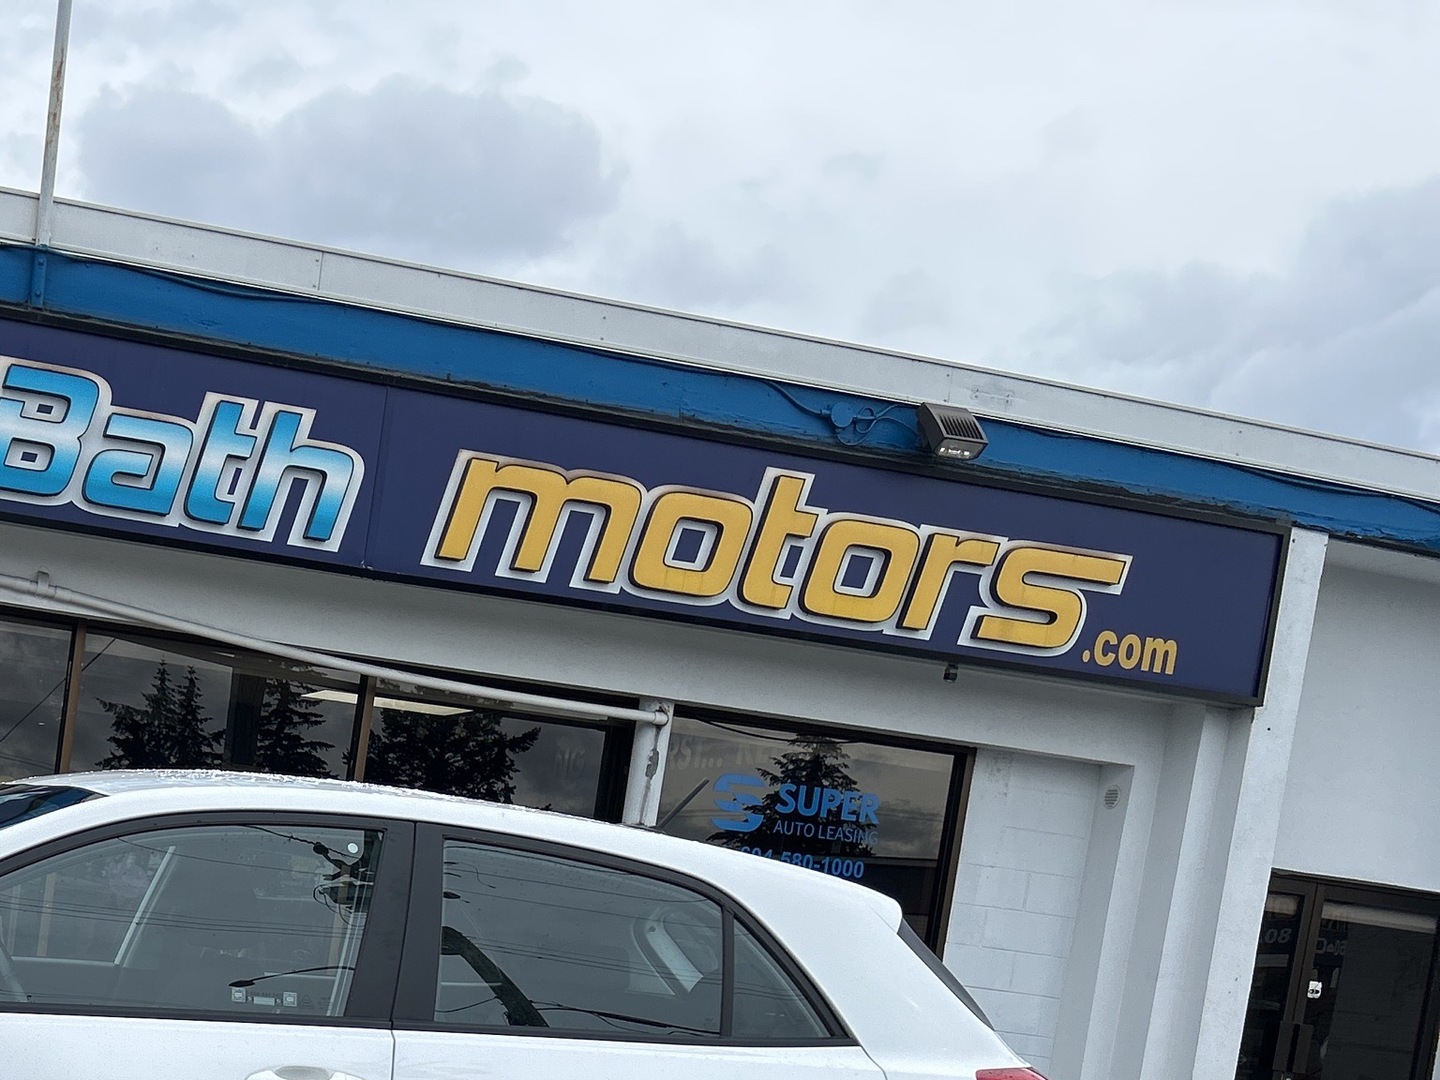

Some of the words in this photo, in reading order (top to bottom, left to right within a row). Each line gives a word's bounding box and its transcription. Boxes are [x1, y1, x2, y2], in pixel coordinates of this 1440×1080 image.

[422, 450, 1132, 657] motors
[1082, 630, 1177, 674] .com
[775, 783, 880, 825] SUPER
[773, 820, 815, 838] AUTO
[818, 825, 879, 845] LEASING
